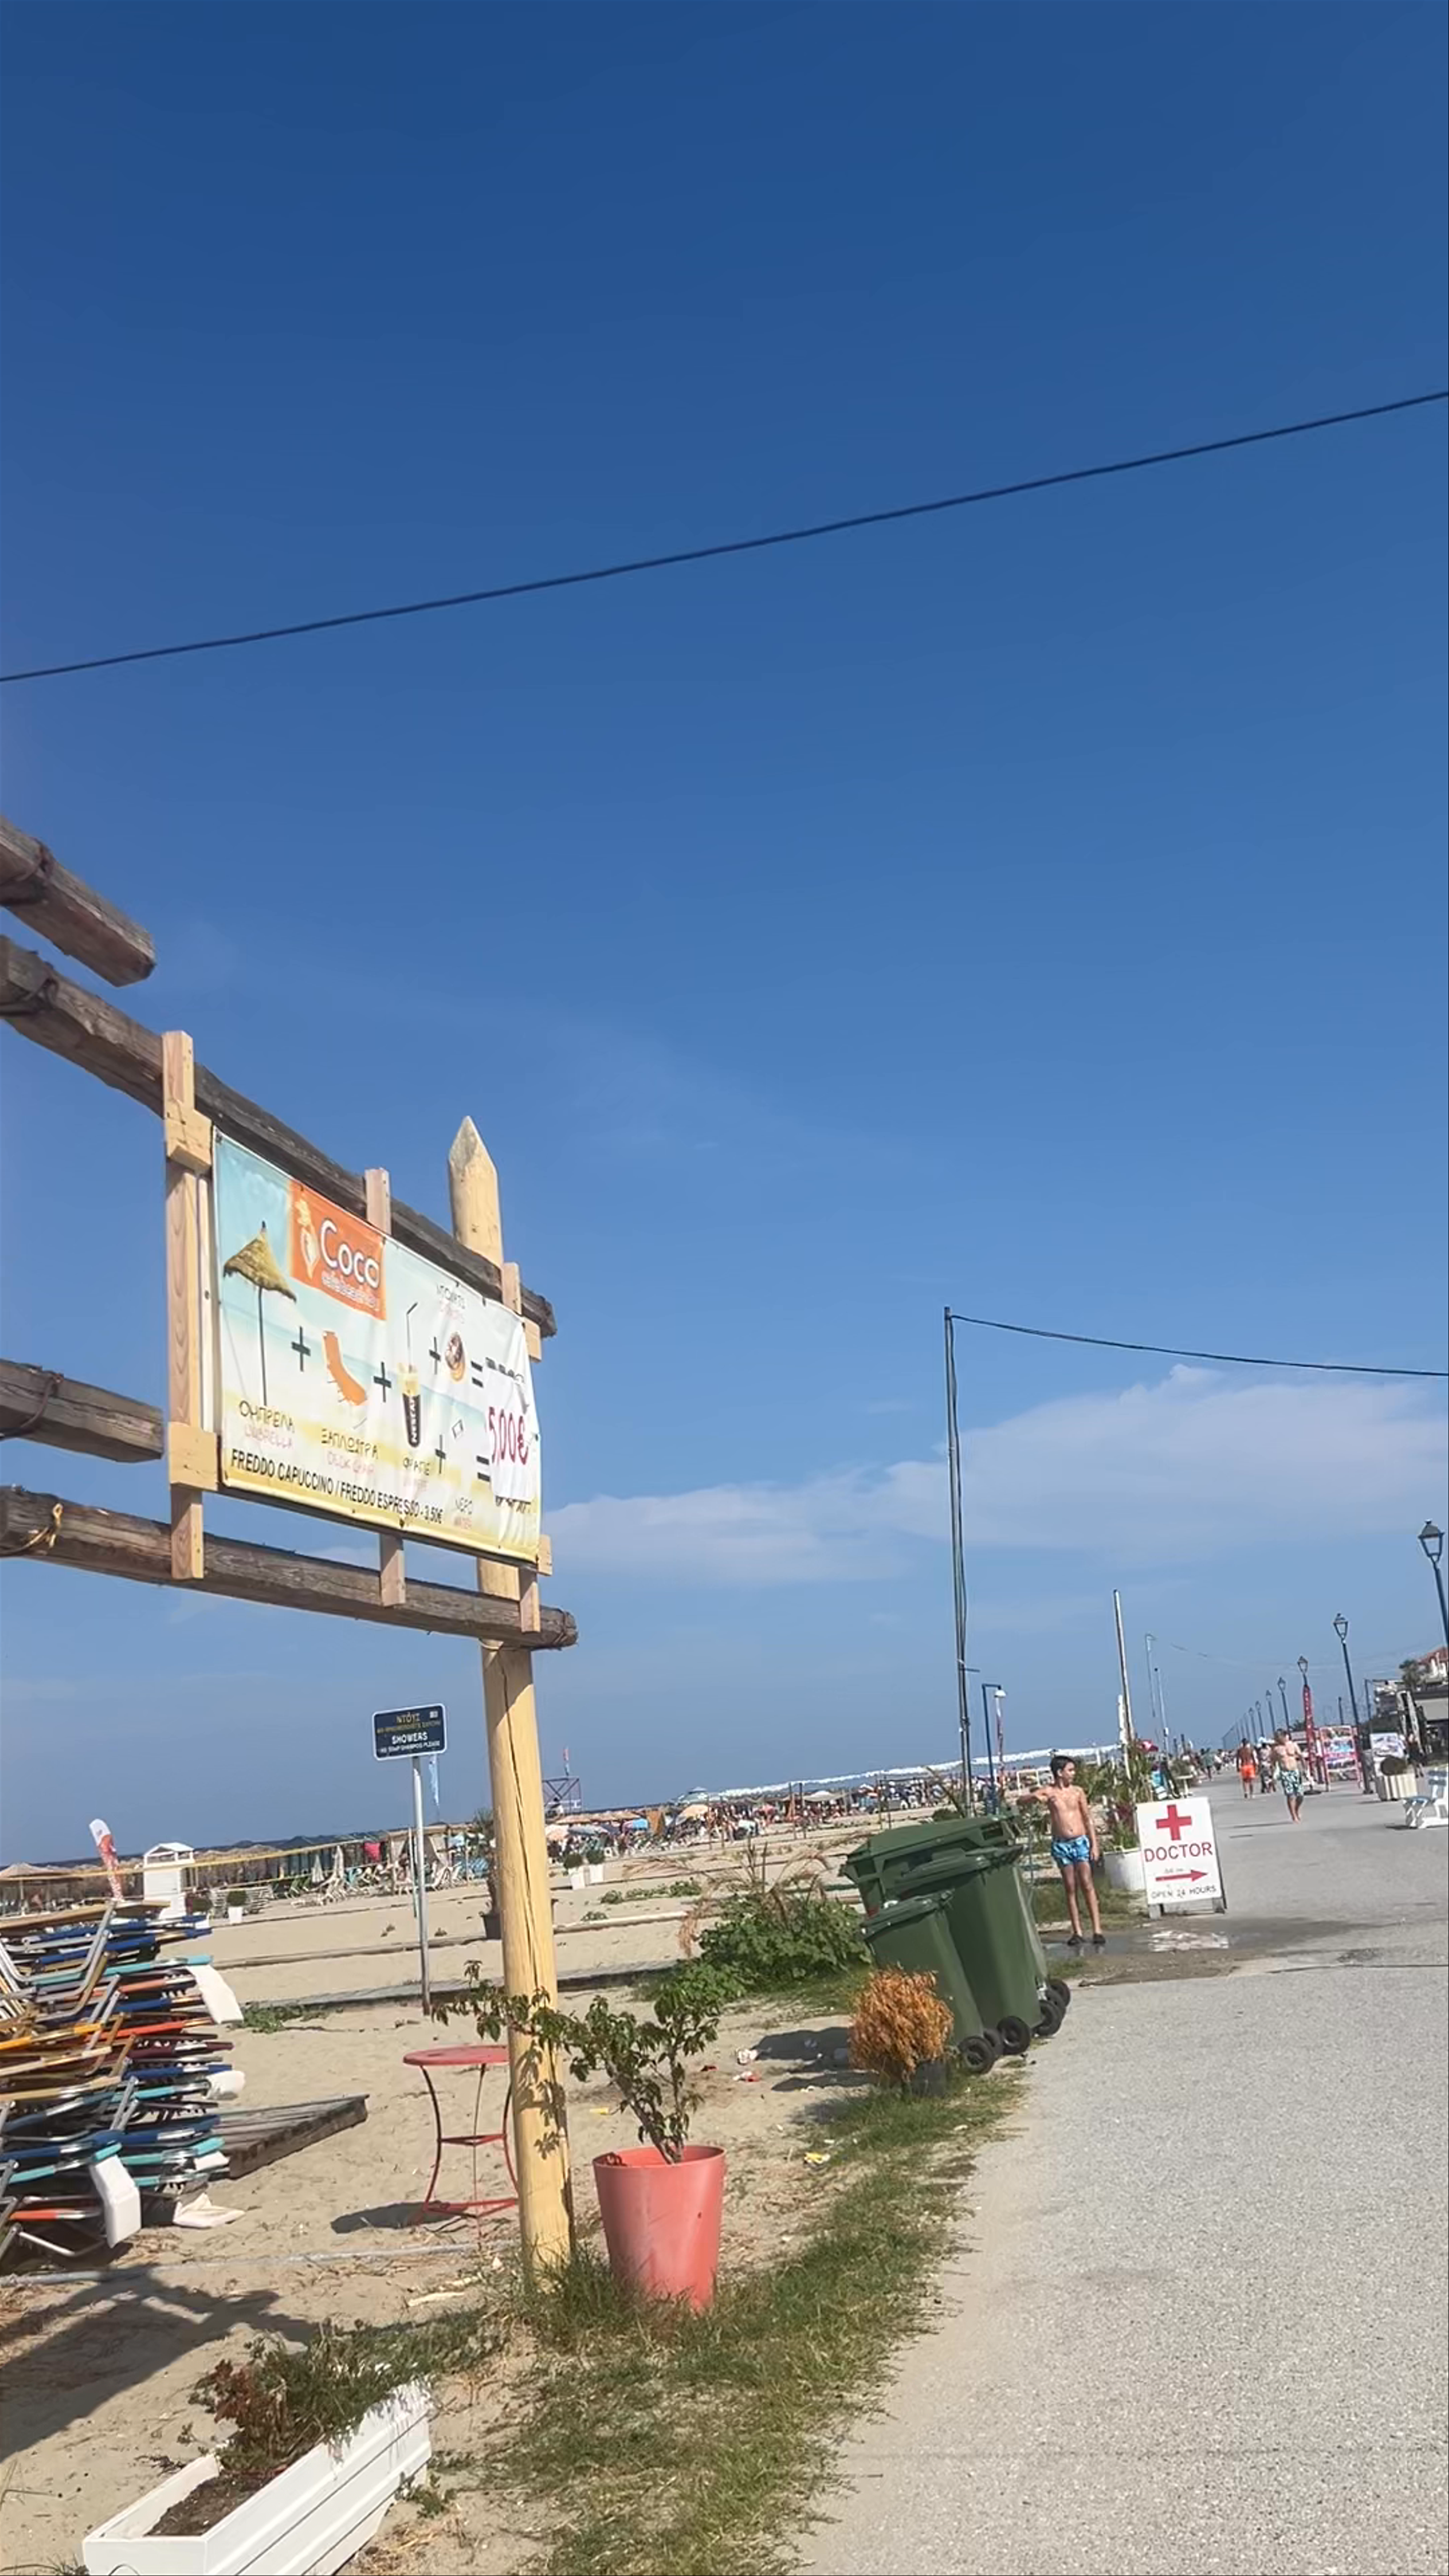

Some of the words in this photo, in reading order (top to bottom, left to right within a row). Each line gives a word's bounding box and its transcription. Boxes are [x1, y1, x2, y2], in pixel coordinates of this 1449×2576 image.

[321, 1218, 380, 1289] Coco
[231, 1449, 275, 1477] FREDDO
[278, 1463, 334, 1495] CAPUCCINO
[340, 1481, 375, 1506] FREDDO
[378, 1491, 420, 1517] ESPRESSO
[392, 1731, 428, 1744] SHOWERS
[1144, 1842, 1213, 1862] DOCTOR
[1151, 1890, 1172, 1899] OPEN
[1189, 1885, 1217, 1895] HOURS
